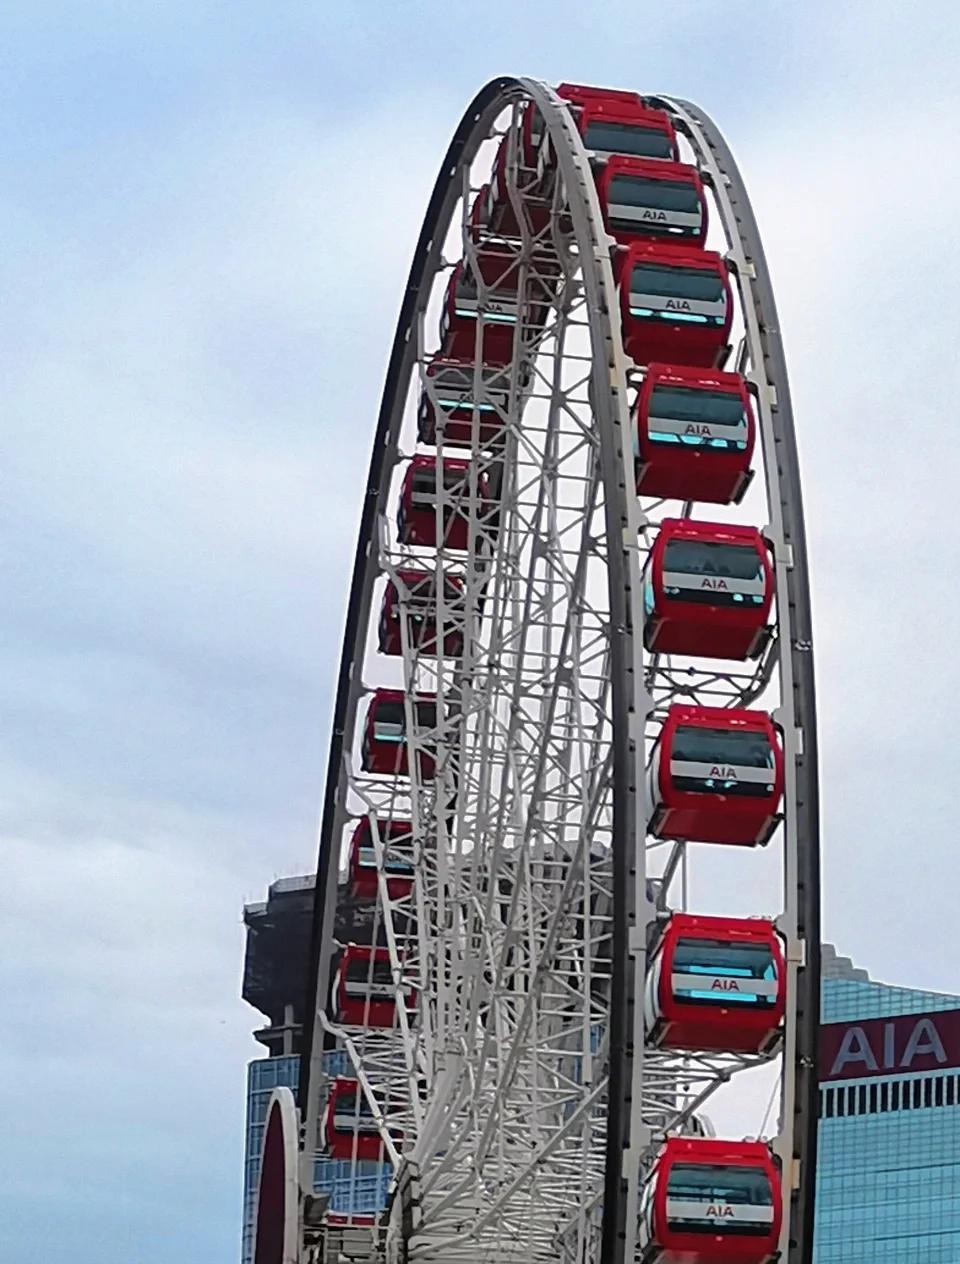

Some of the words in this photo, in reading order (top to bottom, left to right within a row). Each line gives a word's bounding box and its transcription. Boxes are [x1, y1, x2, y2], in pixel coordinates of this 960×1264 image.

[643, 210, 667, 221] AIA
[666, 299, 690, 311] AIA
[685, 424, 712, 436] AIA
[702, 578, 728, 590] AIA
[710, 766, 737, 779] AIA
[711, 979, 739, 991] AIA
[829, 1018, 948, 1076] AIA
[706, 1206, 734, 1218] AIA
